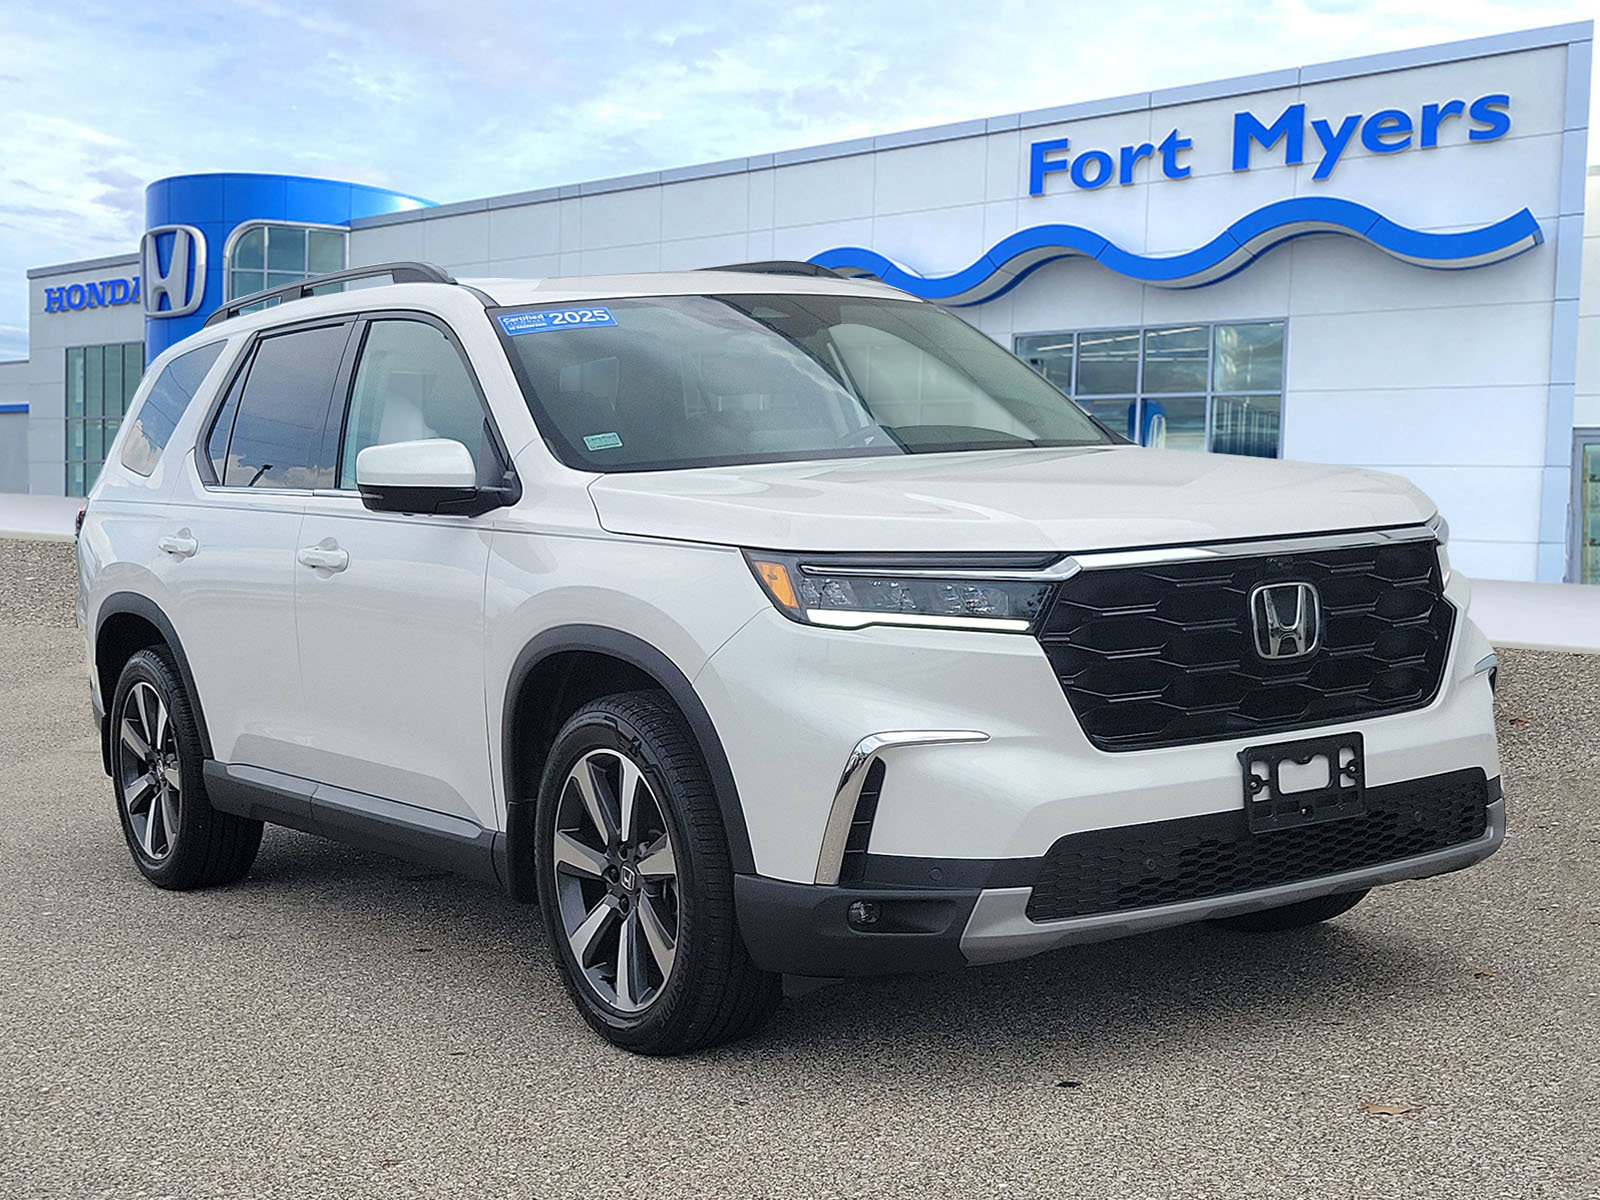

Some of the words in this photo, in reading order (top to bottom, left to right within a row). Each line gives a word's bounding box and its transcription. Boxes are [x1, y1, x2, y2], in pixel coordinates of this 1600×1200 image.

[1029, 128, 1193, 196] Fort
[1232, 93, 1513, 182] Myers
[547, 310, 610, 325] 2025
